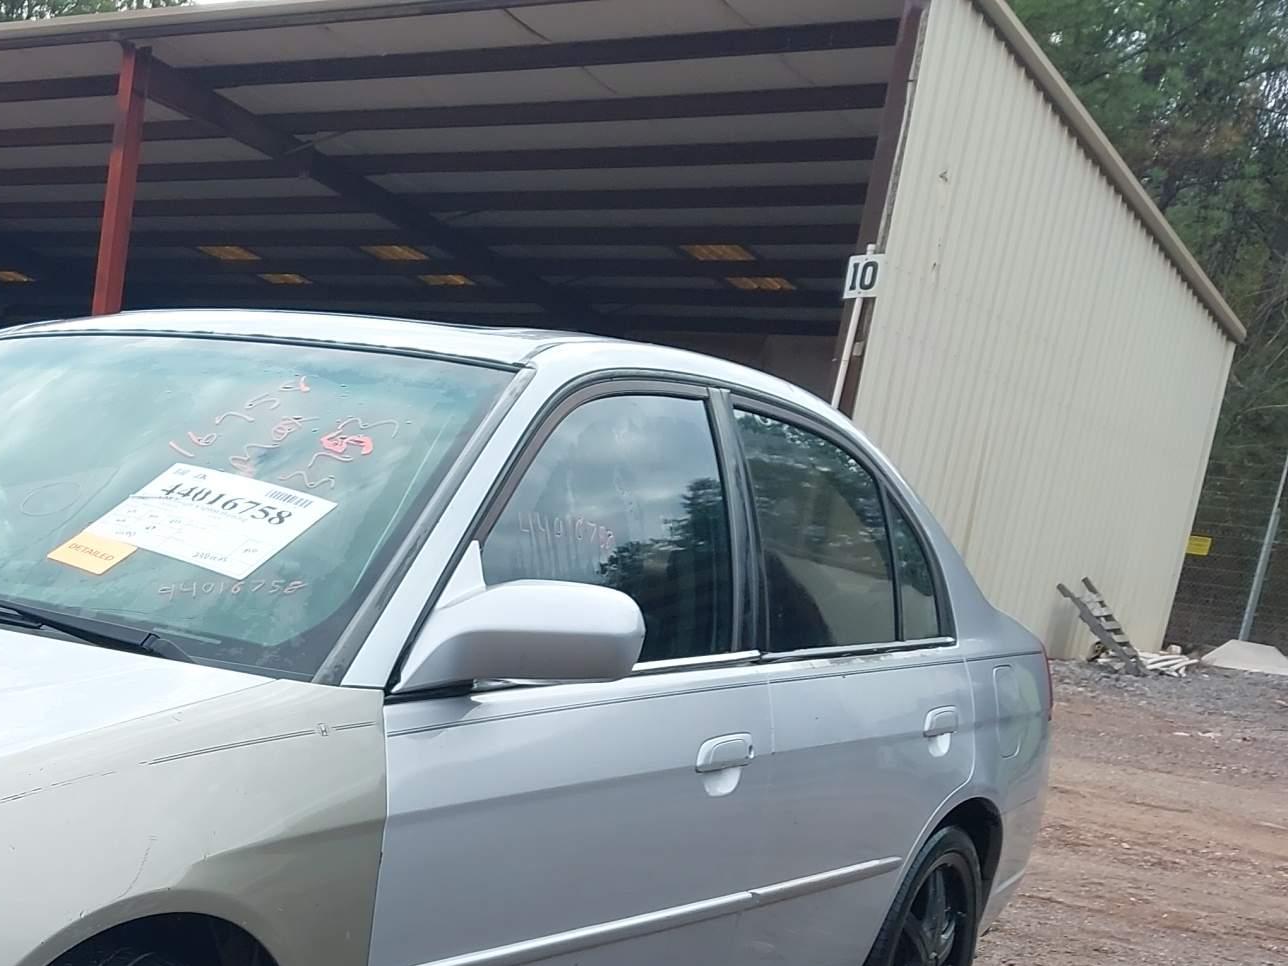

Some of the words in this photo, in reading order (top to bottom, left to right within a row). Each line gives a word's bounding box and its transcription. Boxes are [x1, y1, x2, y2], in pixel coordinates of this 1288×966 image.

[848, 261, 879, 291] 10
[160, 482, 293, 526] 44016758
[68, 542, 115, 561] DETAILED
